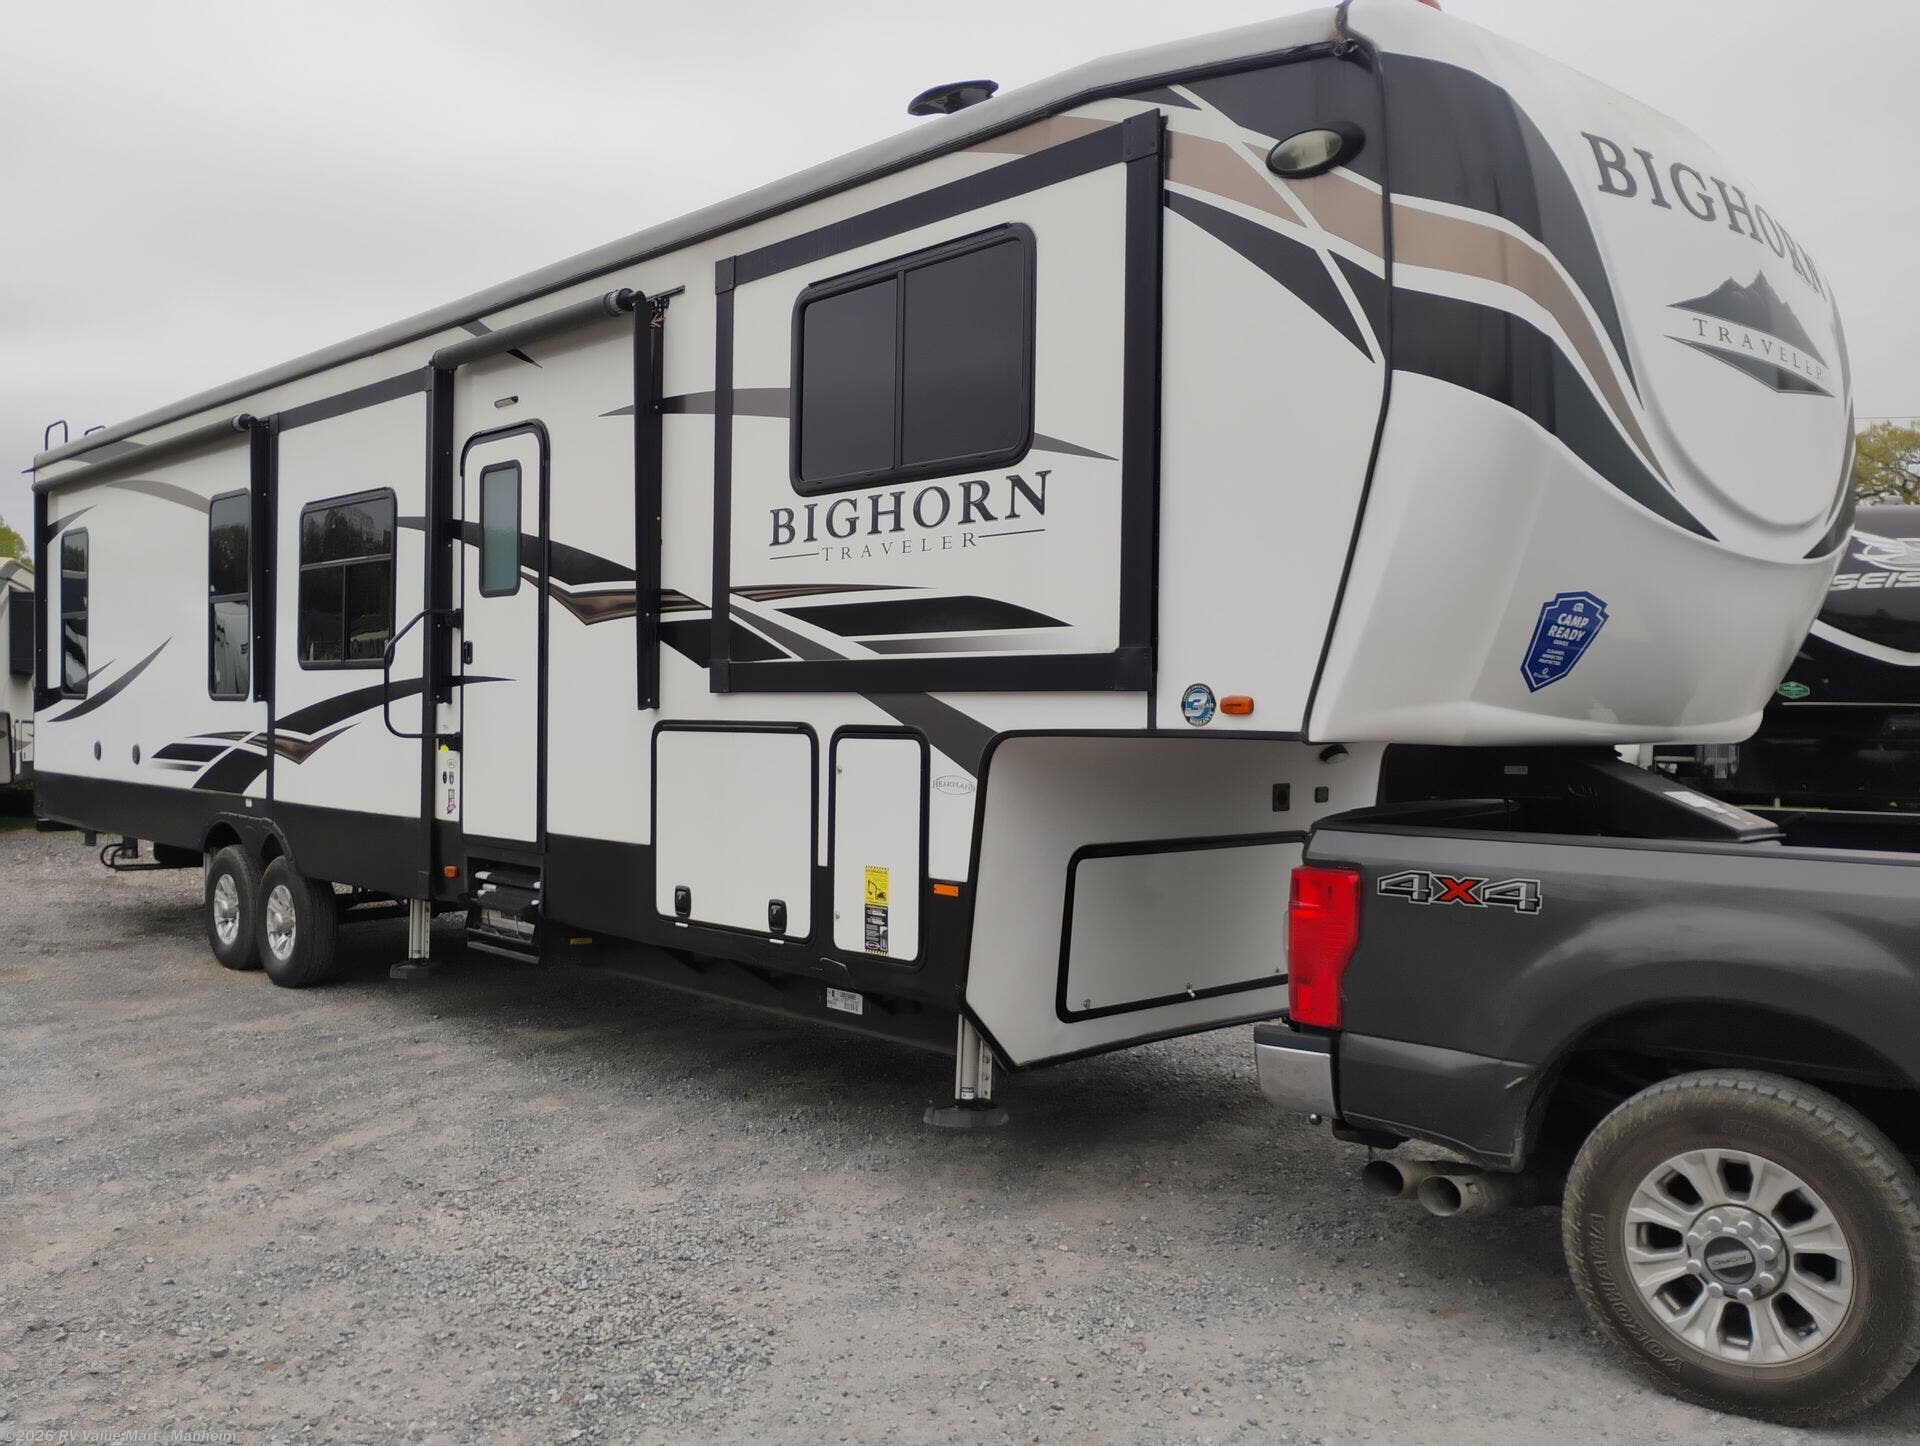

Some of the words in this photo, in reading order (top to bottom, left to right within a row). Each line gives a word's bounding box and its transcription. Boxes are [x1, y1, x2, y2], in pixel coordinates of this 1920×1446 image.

[1581, 131, 1828, 303] BIGHORN
[1693, 317, 1825, 383] TRAVELER
[769, 469, 1052, 547] BIGHORN
[821, 531, 977, 562] TRAVELER
[1547, 625, 1586, 642] READY
[1557, 613, 1589, 628] CAMP
